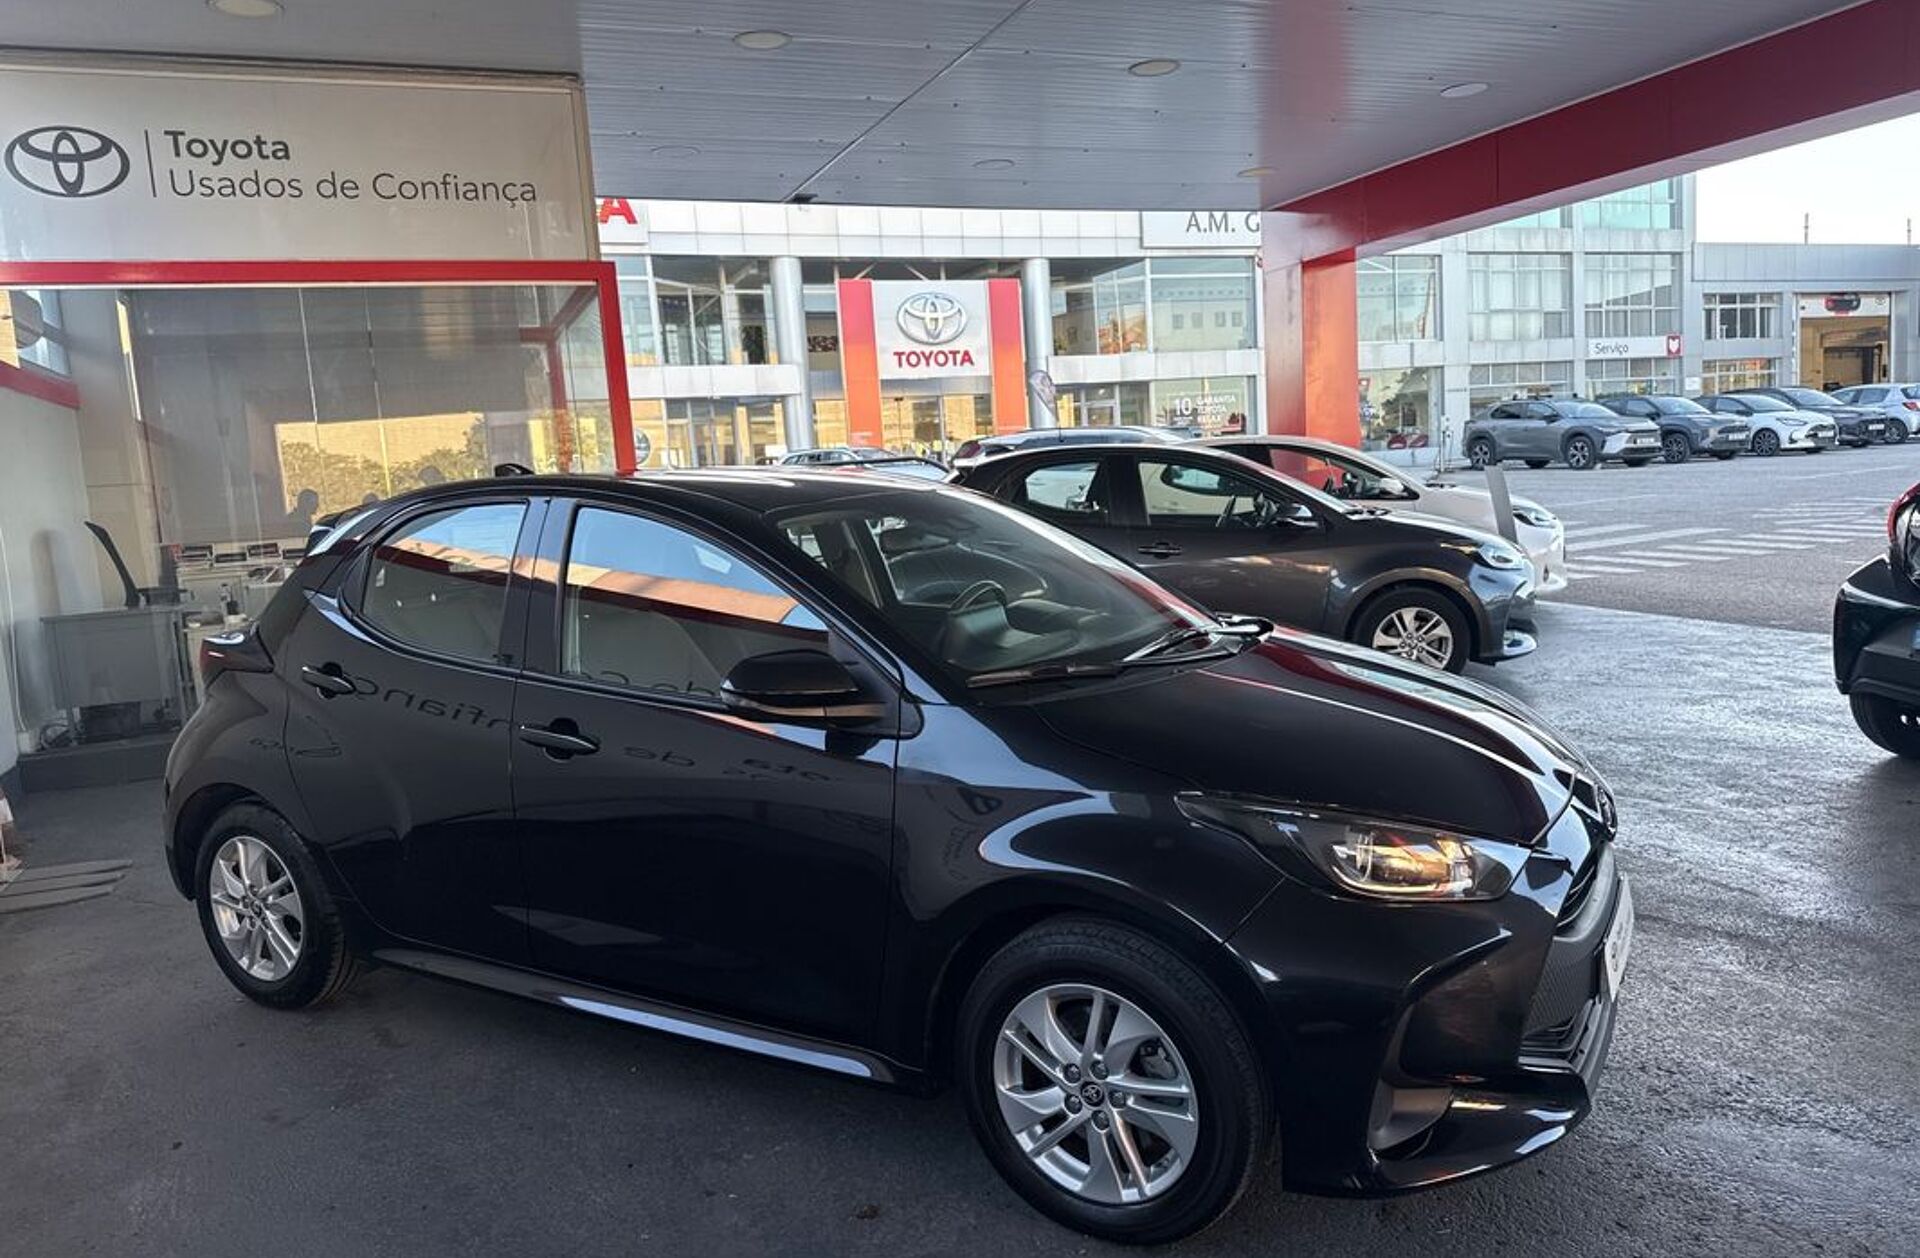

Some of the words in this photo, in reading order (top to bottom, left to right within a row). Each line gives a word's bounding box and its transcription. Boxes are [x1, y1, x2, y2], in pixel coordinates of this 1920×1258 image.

[164, 129, 291, 167] Toyota
[169, 169, 303, 199] Usados
[316, 171, 360, 200] de
[372, 173, 537, 208] Confiança
[599, 197, 638, 224] A
[1244, 212, 1260, 233] G
[893, 350, 975, 368] TOYOTA
[1595, 342, 1629, 355] Serviço
